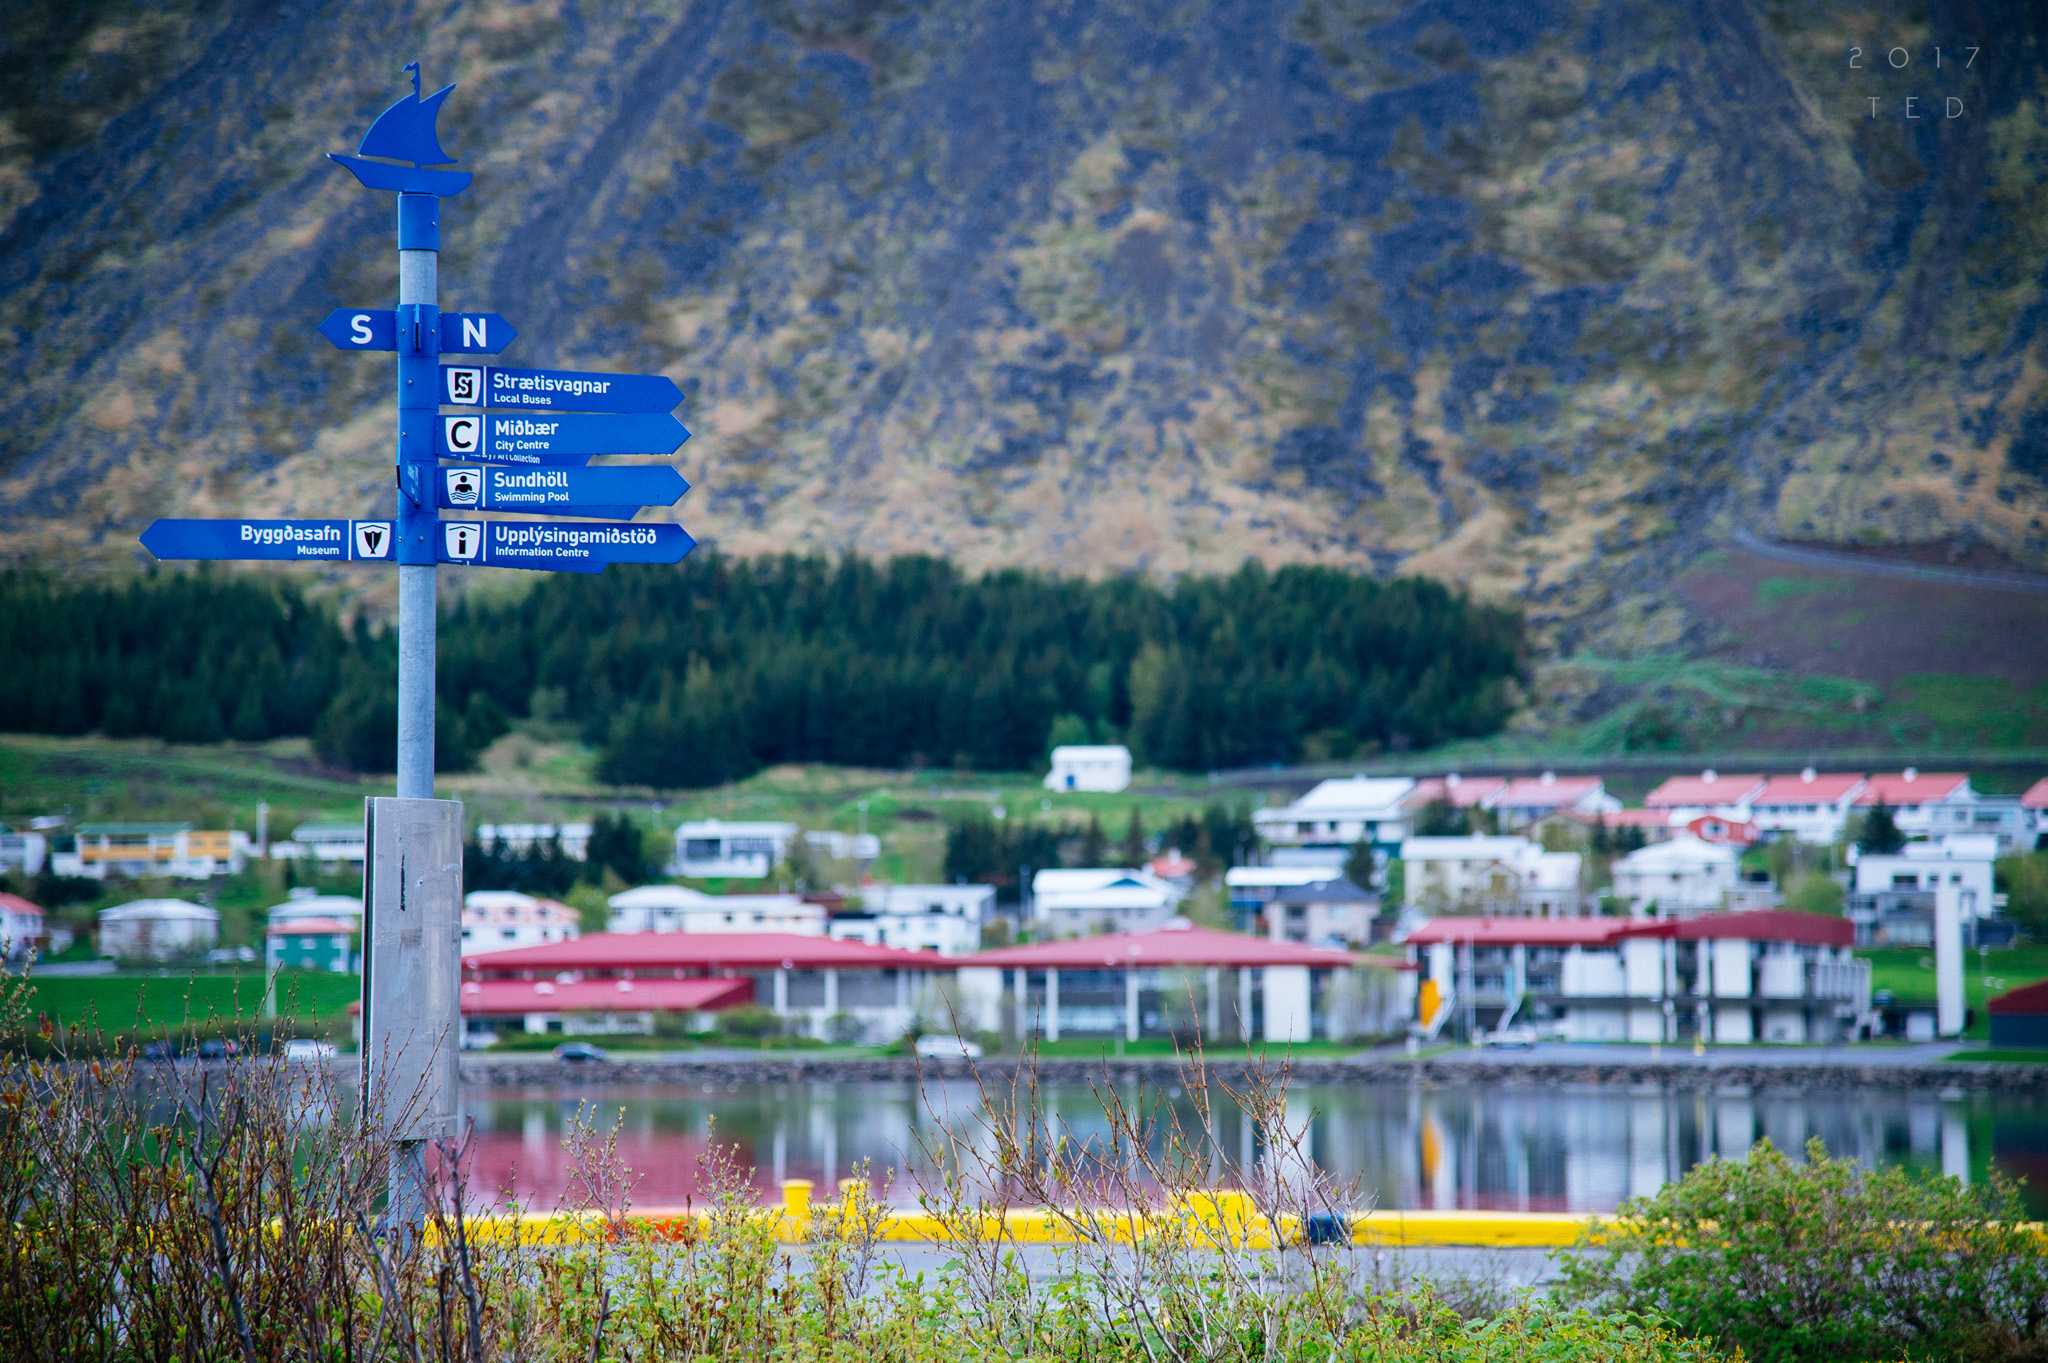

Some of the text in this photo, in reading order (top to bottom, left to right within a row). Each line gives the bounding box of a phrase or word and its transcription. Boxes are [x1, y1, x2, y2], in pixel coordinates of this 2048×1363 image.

[350, 314, 373, 345] S
[463, 318, 487, 348] N
[493, 373, 611, 396] Strætisvagnar
[494, 393, 552, 406] Local Buses
[451, 420, 473, 449] C
[495, 419, 560, 436] Miðbær
[495, 440, 550, 452] City Centre
[494, 471, 569, 488] Sundhöll
[495, 491, 570, 504] Swimming Pool
[241, 525, 341, 545] Byggðasafn
[496, 526, 657, 546] Upplýsingamiðstöð
[297, 545, 340, 555] Museum
[495, 547, 590, 558] Information Centre
